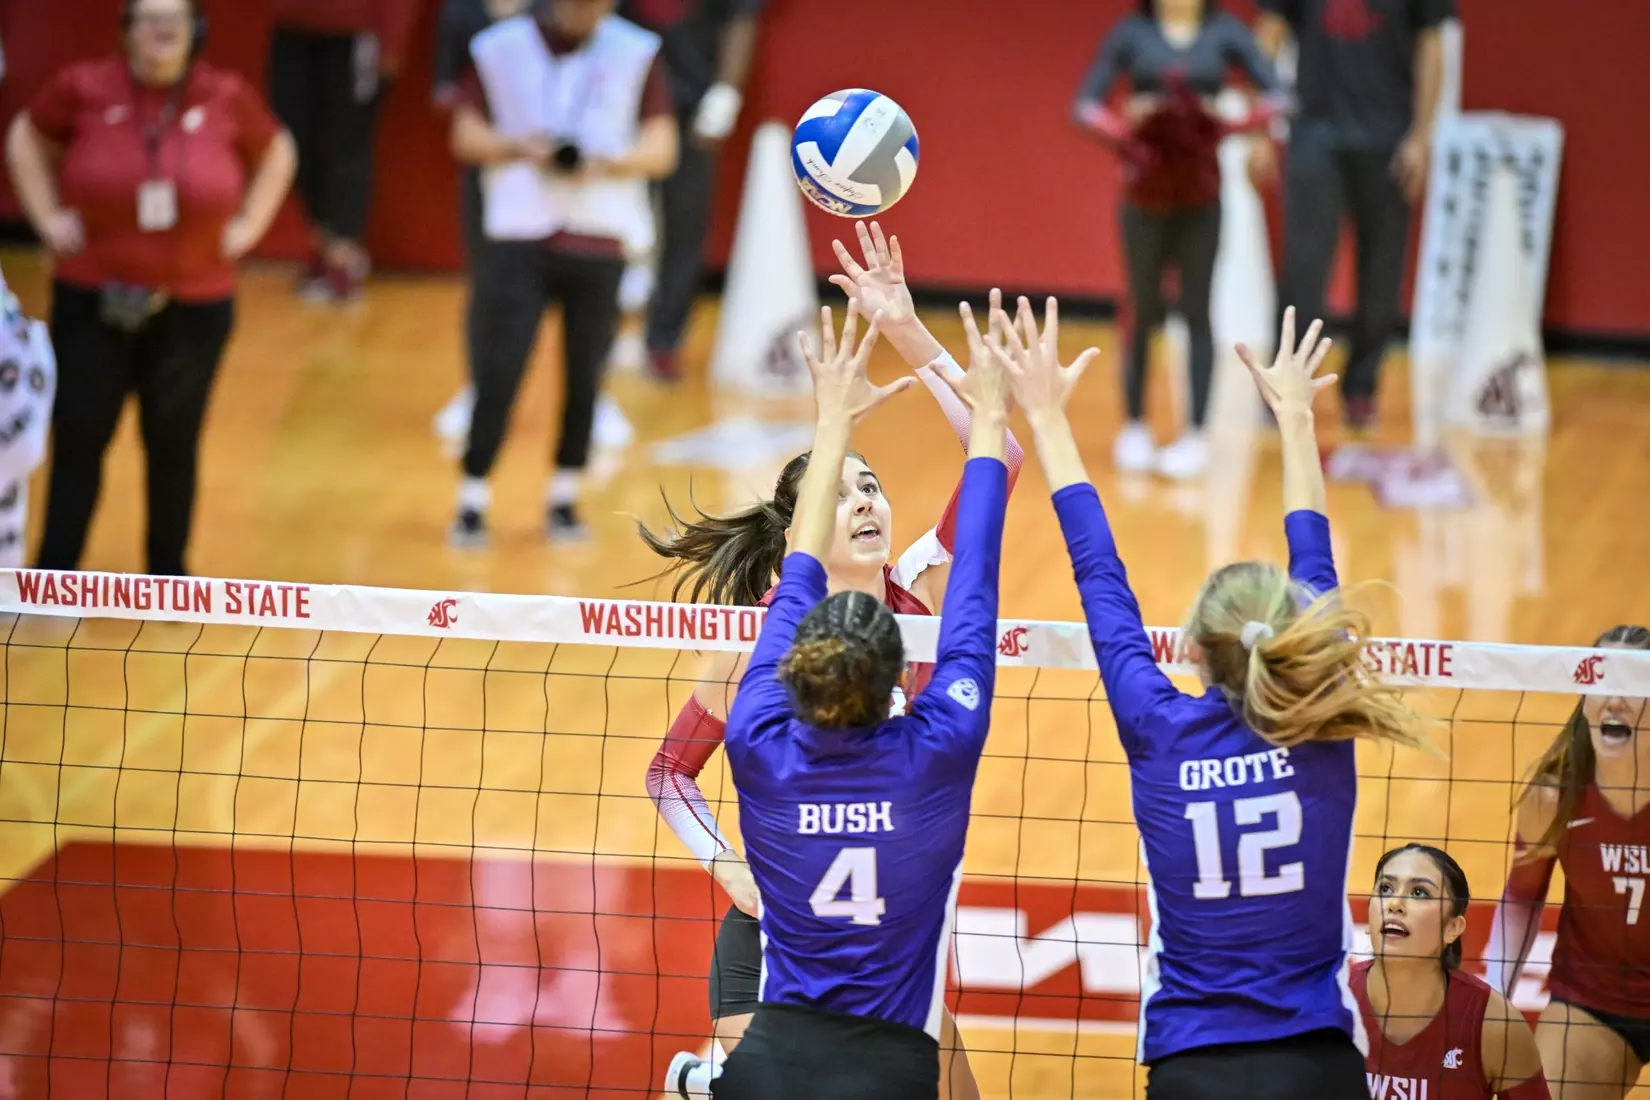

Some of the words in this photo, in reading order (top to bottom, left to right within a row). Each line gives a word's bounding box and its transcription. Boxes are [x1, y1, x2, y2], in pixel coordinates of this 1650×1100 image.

[16, 571, 212, 614] WASHINGTON
[225, 581, 311, 619] STATE
[1366, 641, 1453, 677] STATE
[1179, 747, 1295, 791] GROTE
[797, 801, 895, 834] BUSH
[1184, 790, 1304, 899] 12
[809, 847, 886, 926] 4
[1612, 877, 1646, 925] 7
